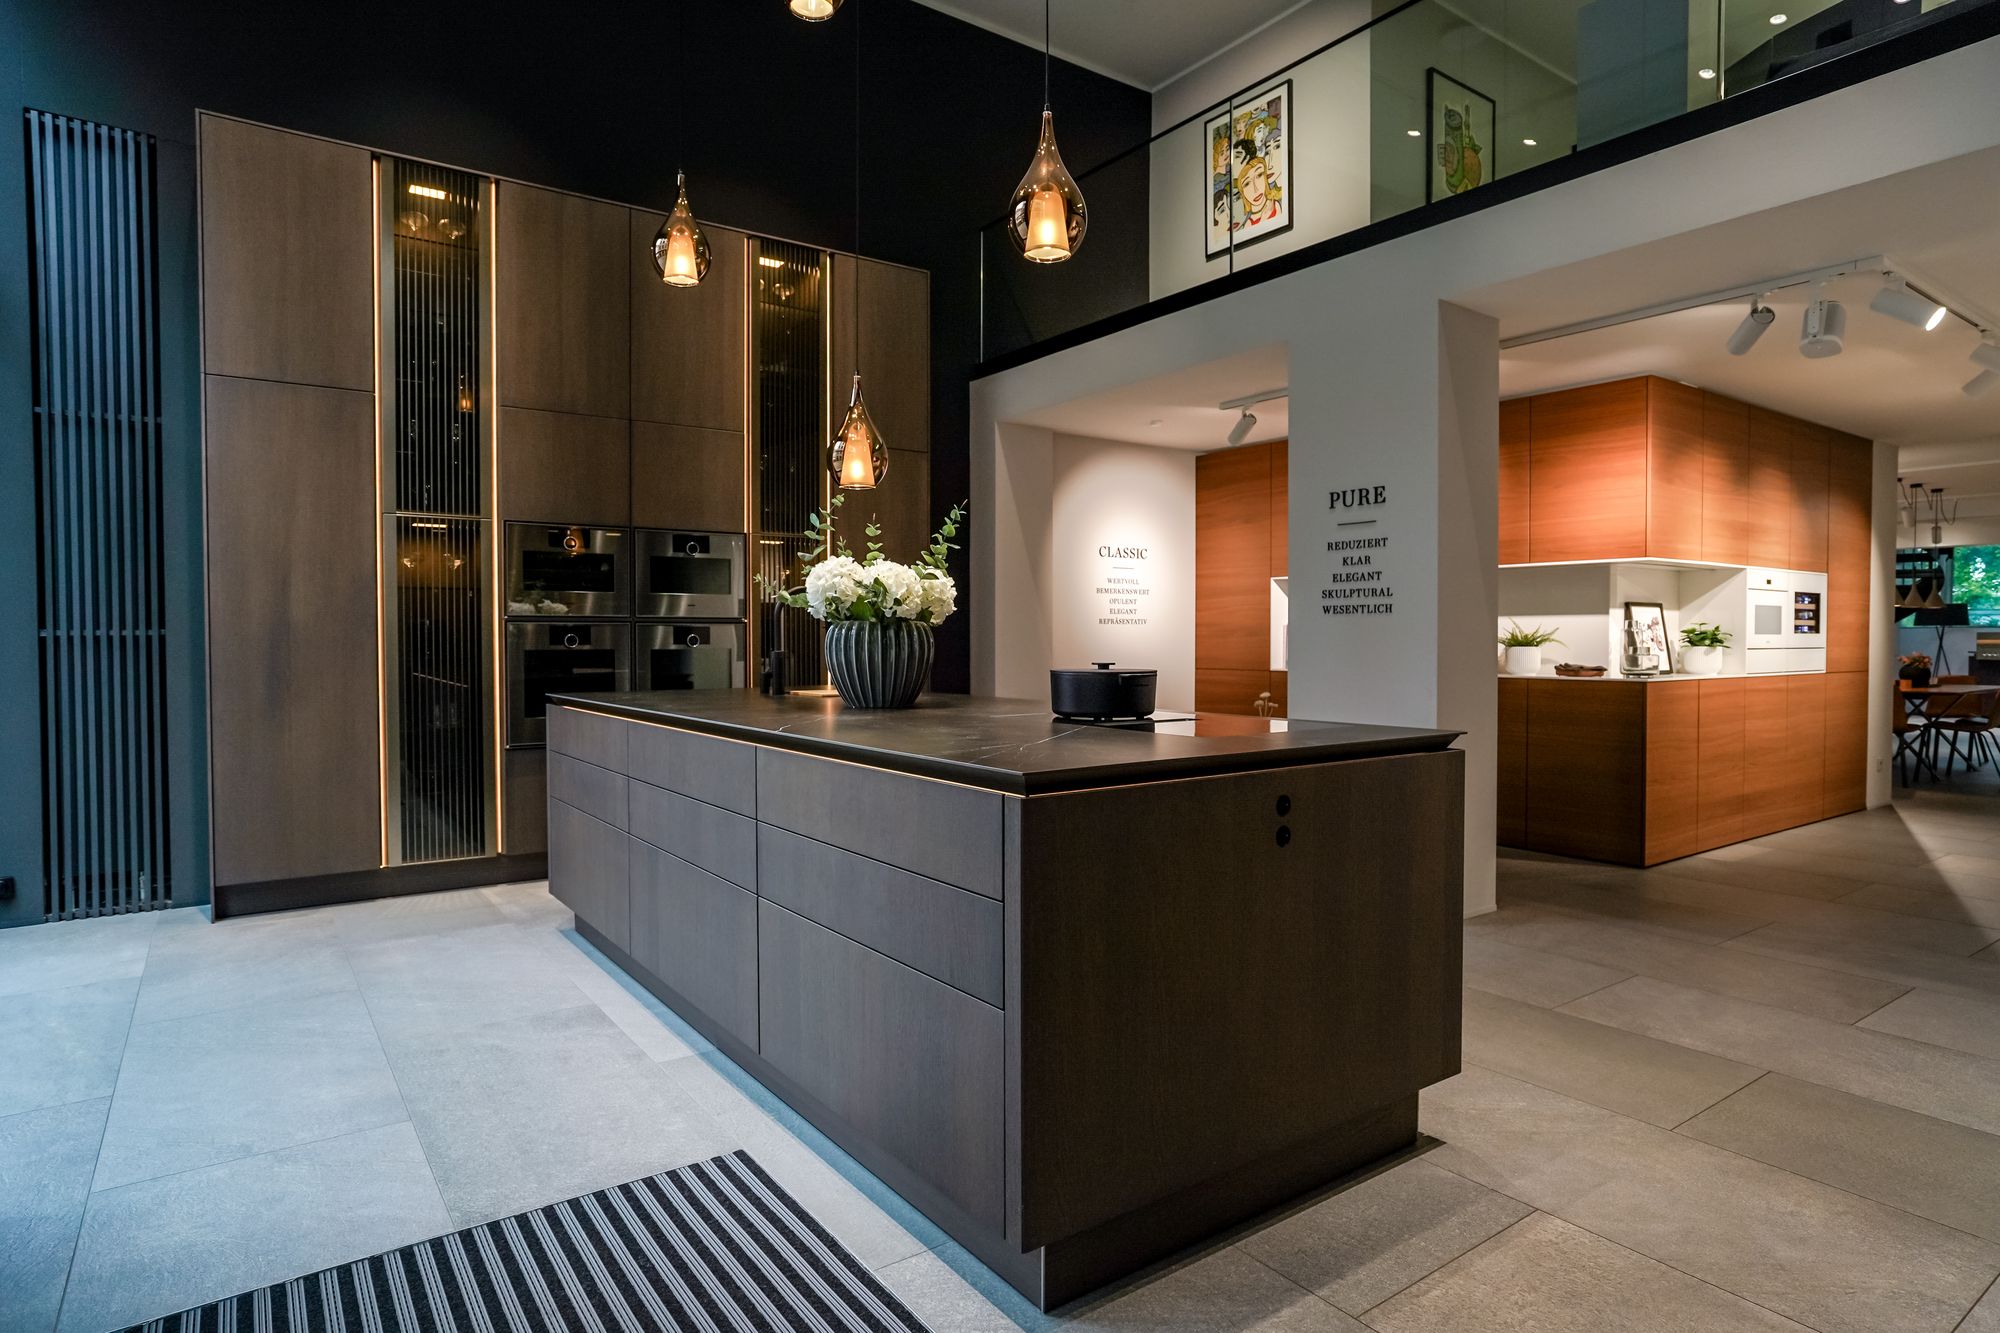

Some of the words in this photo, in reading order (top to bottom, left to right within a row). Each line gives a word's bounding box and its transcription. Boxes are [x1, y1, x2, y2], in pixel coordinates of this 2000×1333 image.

[1329, 486, 1387, 510] PURE
[1327, 537, 1389, 551] REDUZIERT
[1098, 546, 1148, 560] CLASSIC
[1342, 555, 1371, 567] KLAR
[1106, 577, 1140, 585] WERTVOLL
[1332, 571, 1383, 584] ELEGANT
[1096, 587, 1150, 595] BEMERKENSWERT
[1321, 587, 1394, 600] SKULPTURAL
[1322, 604, 1393, 615] WESENTLICH
[1098, 617, 1148, 625] REPRÄSENTATIV
